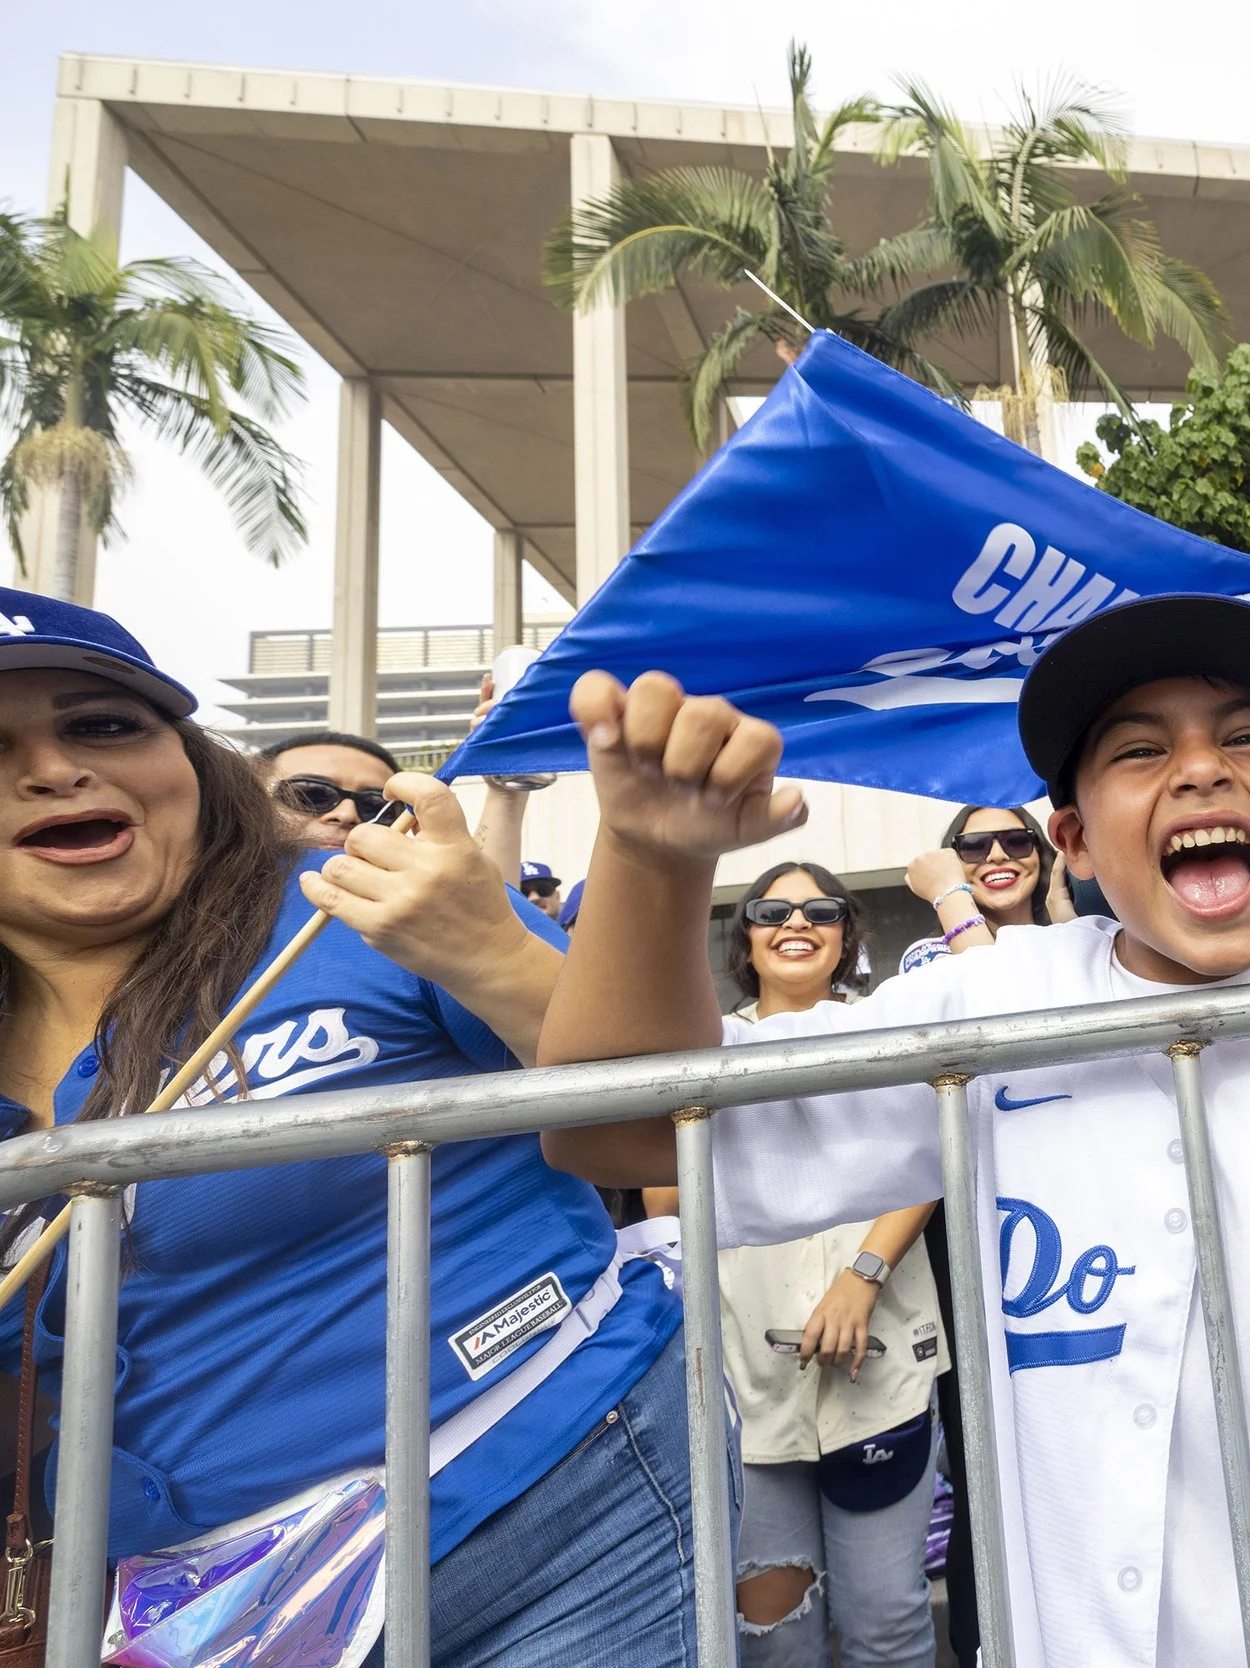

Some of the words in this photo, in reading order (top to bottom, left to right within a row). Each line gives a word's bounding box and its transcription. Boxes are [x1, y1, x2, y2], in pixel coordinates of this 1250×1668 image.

[952, 522, 1141, 633] CHA
[475, 1344, 500, 1365] MAJOR
[502, 1322, 531, 1347] LEAGUE
[531, 1300, 564, 1327] BASEBALL
[493, 1290, 551, 1334] Majestic
[863, 1444, 893, 1464] LA
